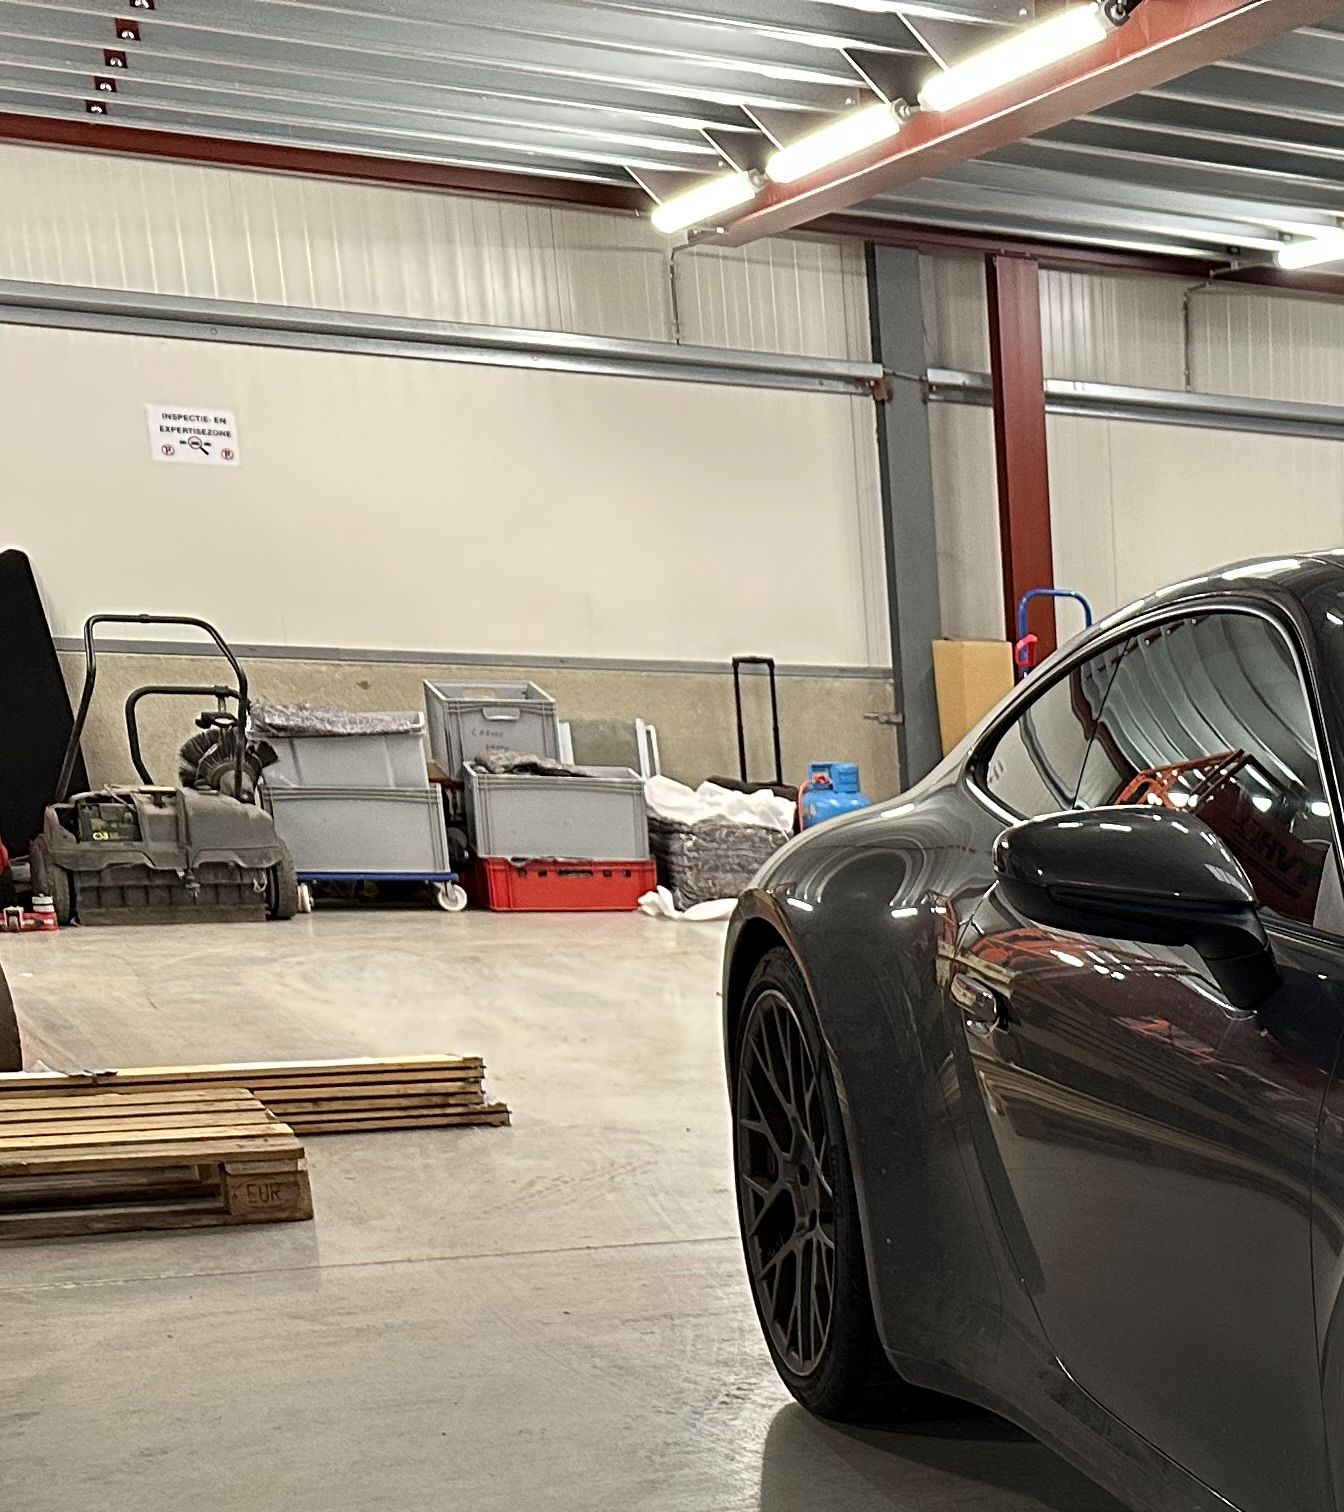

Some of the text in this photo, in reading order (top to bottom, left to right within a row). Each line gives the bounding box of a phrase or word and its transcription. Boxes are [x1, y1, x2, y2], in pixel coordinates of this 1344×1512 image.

[214, 416, 227, 425] EN
[160, 425, 232, 438] EXPERTISEZONE
[247, 1182, 281, 1203] EUR
